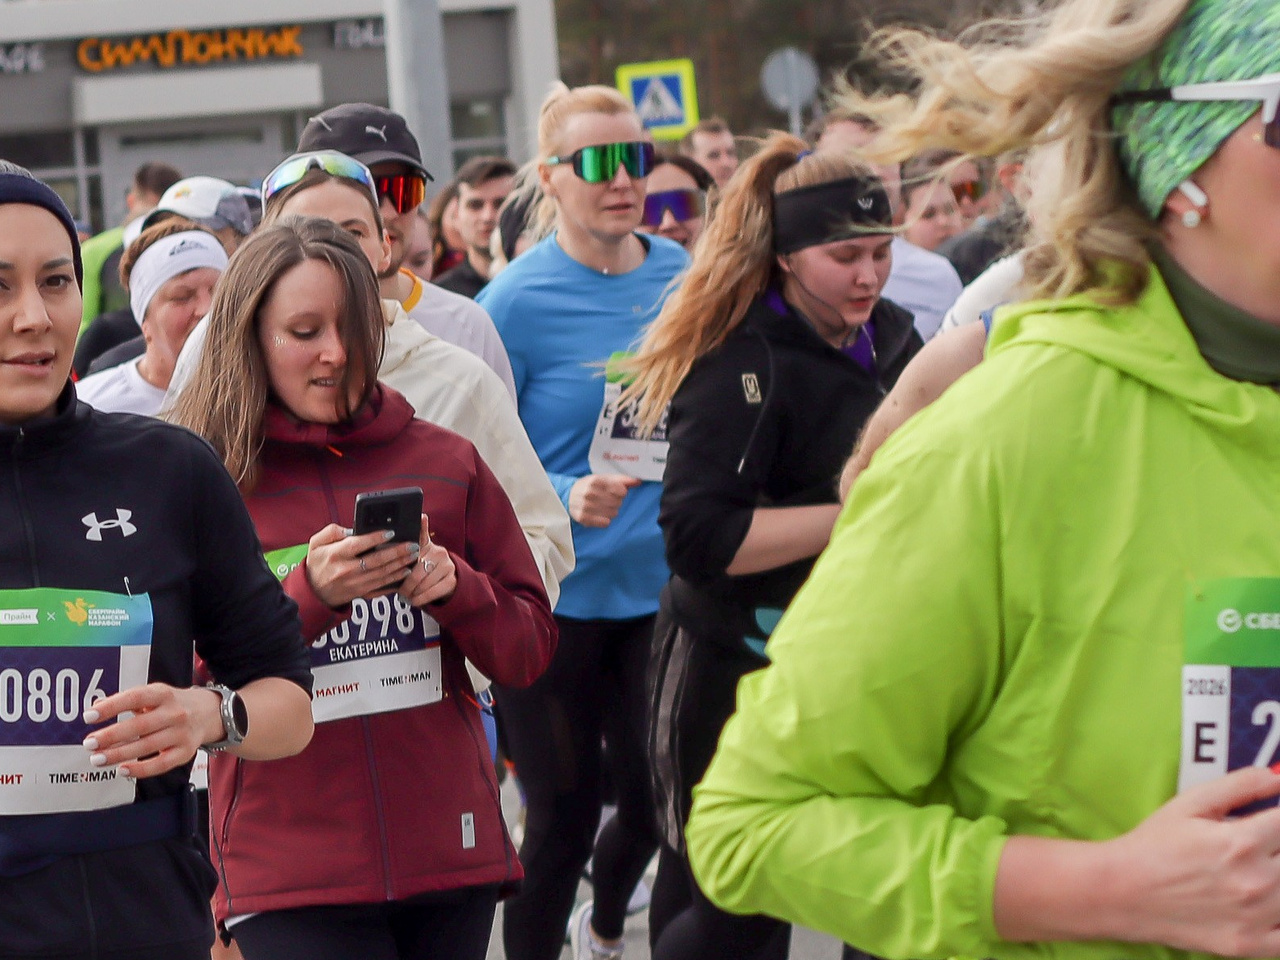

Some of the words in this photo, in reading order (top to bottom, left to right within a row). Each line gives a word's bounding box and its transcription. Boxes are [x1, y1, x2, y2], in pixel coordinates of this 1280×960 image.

[3, 612, 32, 622] Прайм
[311, 592, 415, 649] 998
[328, 638, 399, 662] ЕКАТЕРИНА
[315, 682, 360, 698] МАГНИТ
[1193, 722, 1217, 762] E
